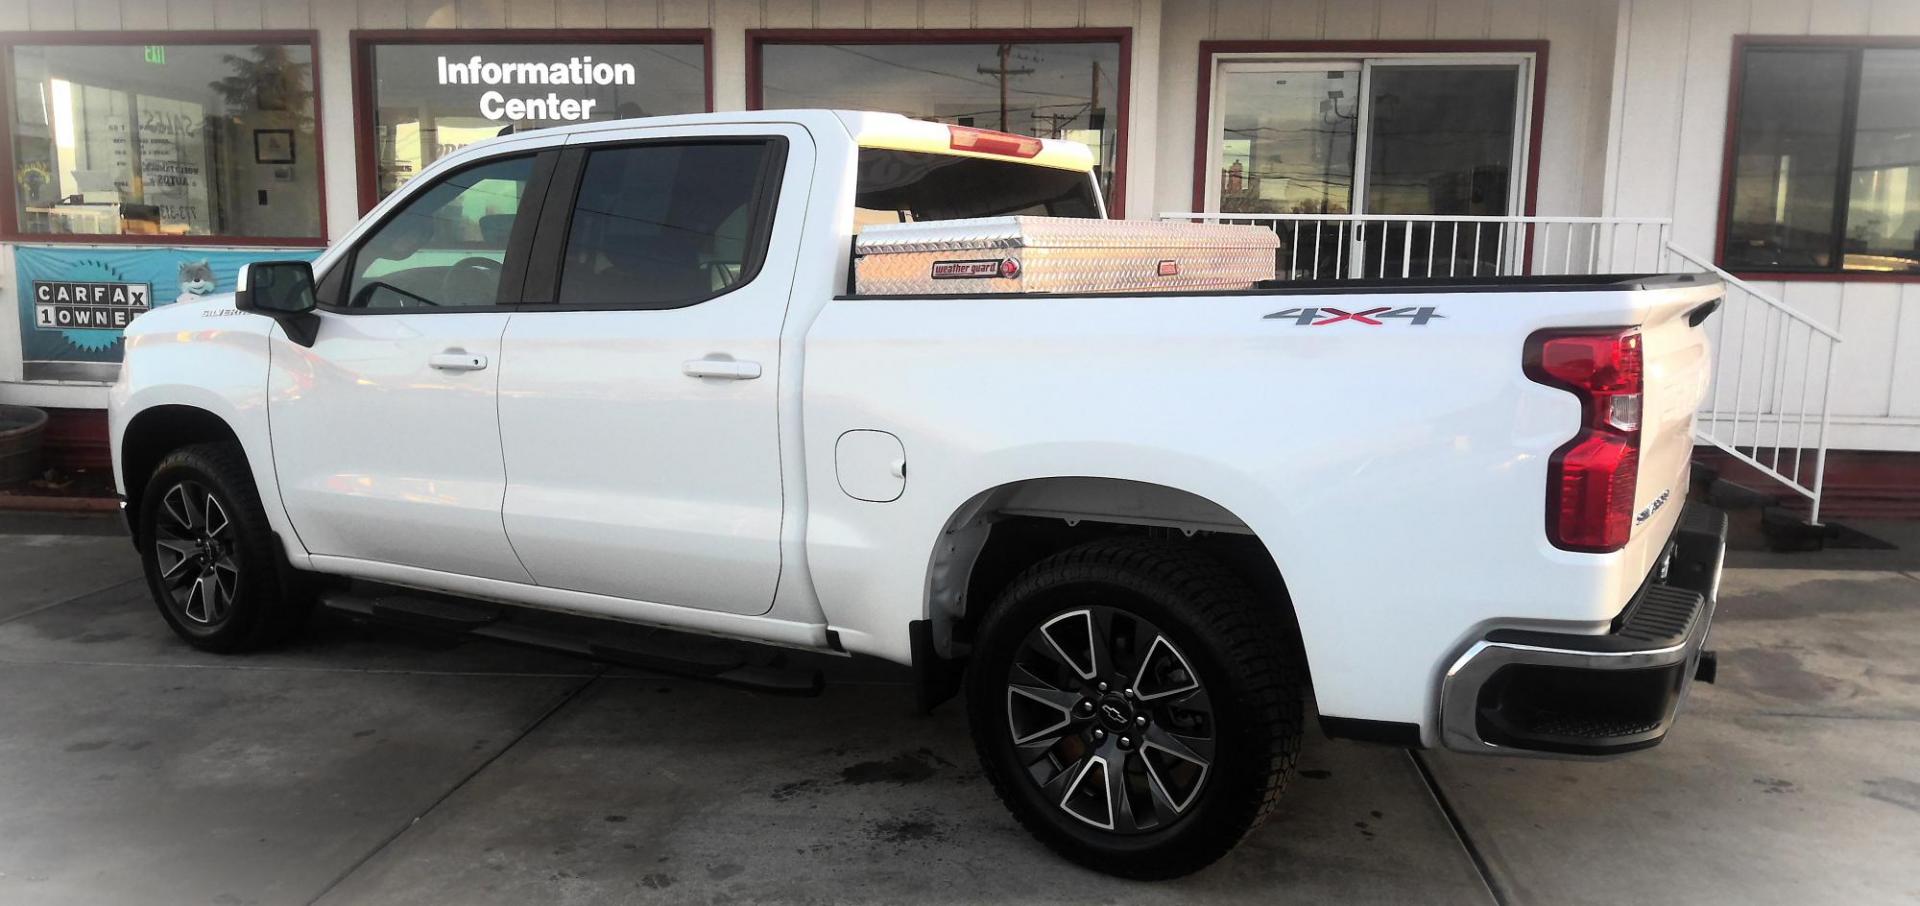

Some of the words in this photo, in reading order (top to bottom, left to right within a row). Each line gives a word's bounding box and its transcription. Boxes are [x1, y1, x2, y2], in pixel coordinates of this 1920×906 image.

[438, 56, 636, 85] Information
[479, 91, 597, 121] Center
[935, 263, 970, 274] weather
[971, 262, 996, 274] guard
[38, 285, 145, 306] CARFAX
